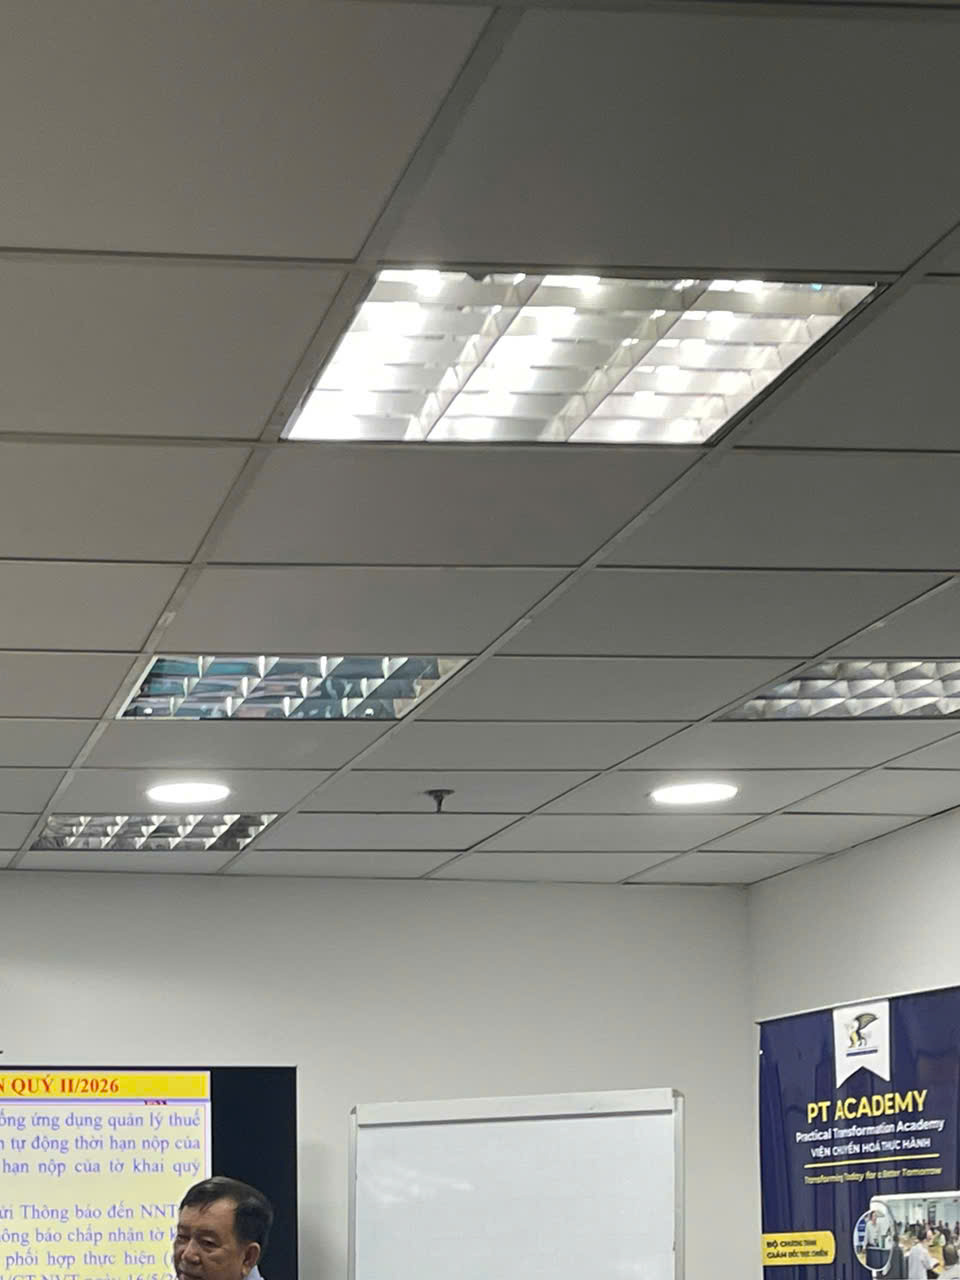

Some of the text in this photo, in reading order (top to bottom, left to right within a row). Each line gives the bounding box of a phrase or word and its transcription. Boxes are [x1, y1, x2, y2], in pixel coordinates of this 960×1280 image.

[11, 1075, 53, 1095] QUÝ
[61, 1079, 118, 1093] II/2026
[807, 1089, 928, 1124] PT ACADEMY
[32, 1112, 60, 1131] ứng
[65, 1112, 103, 1131] dụng
[150, 1112, 163, 1130] lý
[169, 1109, 200, 1126] thuế
[896, 1118, 945, 1132] Academy
[11, 1138, 26, 1152] tự
[31, 1135, 69, 1154] động
[75, 1136, 103, 1150] thời
[110, 1136, 136, 1153] hạn
[142, 1136, 169, 1154] nộp
[2, 1158, 29, 1175] hạn
[38, 1158, 66, 1177] nộp
[110, 1159, 124, 1172] tờ
[133, 1158, 164, 1173] khai
[20, 1204, 69, 1223] Thông
[75, 1204, 102, 1219] báo
[107, 1200, 133, 1219] đến
[141, 1204, 176, 1219] NNT
[36, 1228, 62, 1242] báo
[68, 1223, 102, 1247] chấp
[109, 1227, 144, 1245] nhận
[150, 1227, 164, 1241] tờ
